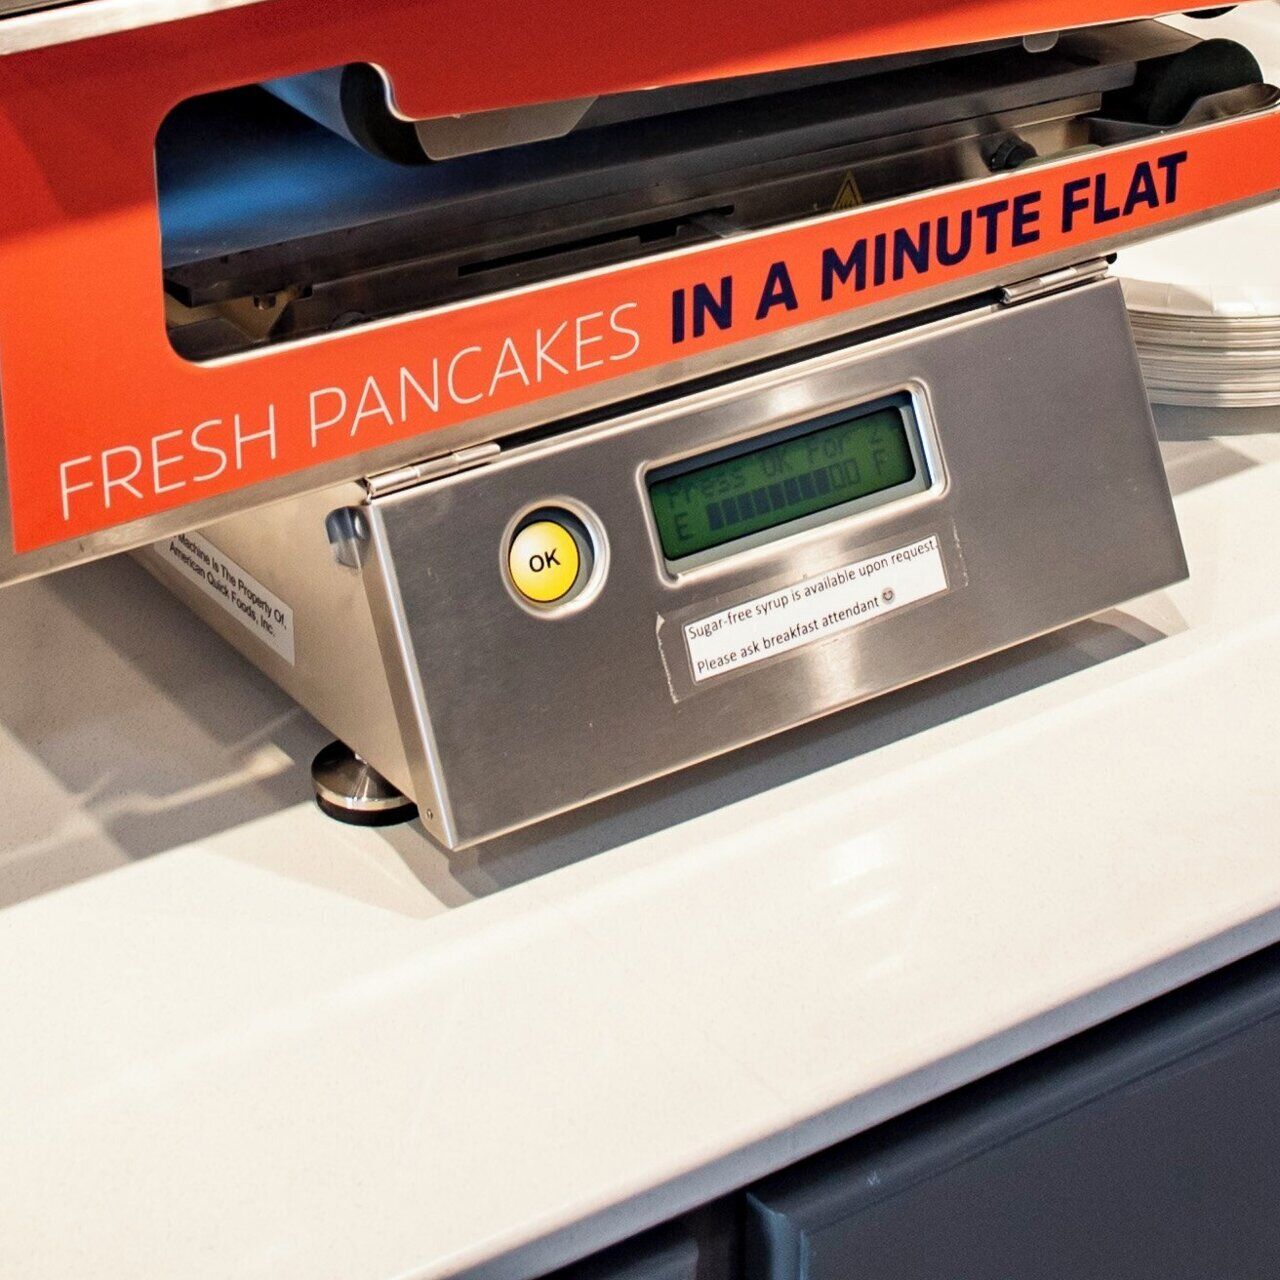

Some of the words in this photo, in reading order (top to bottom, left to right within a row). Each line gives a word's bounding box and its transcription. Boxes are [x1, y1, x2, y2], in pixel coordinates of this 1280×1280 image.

[58, 402, 277, 521] FRESH
[308, 302, 641, 449] PANCAKES
[671, 275, 733, 344] IN
[755, 261, 799, 321] A
[821, 190, 1041, 302] MINUTE
[1062, 151, 1188, 234] FLAT
[169, 541, 206, 580] American
[206, 572, 231, 600] Quick
[221, 564, 237, 587] The
[238, 578, 272, 618] Property
[528, 549, 562, 573] OK
[688, 608, 753, 640] Sugar-free
[754, 594, 790, 617] syrup
[791, 588, 802, 602] is
[804, 569, 857, 598] available
[859, 558, 889, 578] upon
[697, 650, 738, 674] Please
[740, 640, 761, 658] ask
[762, 619, 819, 650] breakfast
[822, 596, 880, 628] attendant
